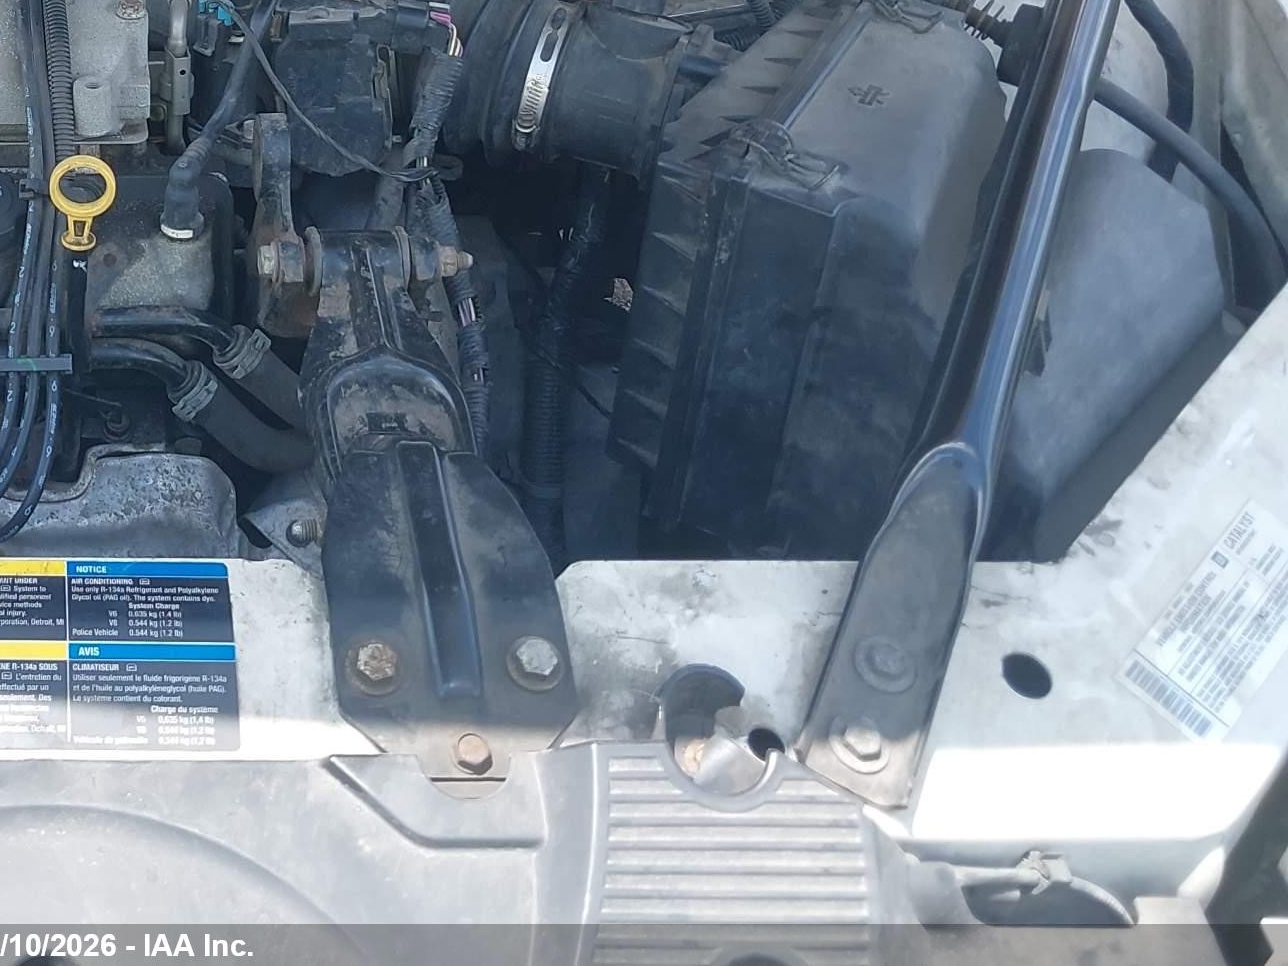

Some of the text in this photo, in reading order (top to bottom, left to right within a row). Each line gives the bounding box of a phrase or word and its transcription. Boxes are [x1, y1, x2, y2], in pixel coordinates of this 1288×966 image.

[10, 322, 16, 334] 2
[1223, 511, 1256, 550] CATALYST
[178, 587, 219, 595] Polyalkylene
[7, 609, 26, 617] injury.
[31, 618, 54, 626] Detroit,
[149, 620, 158, 628] kg
[129, 629, 148, 637] 0.544
[160, 629, 173, 637] (1.2
[78, 647, 99, 656] AVIS
[12, 663, 37, 671] R-134a
[15, 673, 50, 681] L'entretien
[81, 684, 90, 692] de
[92, 684, 113, 692] l'huile
[188, 685, 207, 693] (huile
[39, 694, 51, 702] Des
[153, 695, 182, 703] colorant.
[151, 706, 176, 714] Charge
